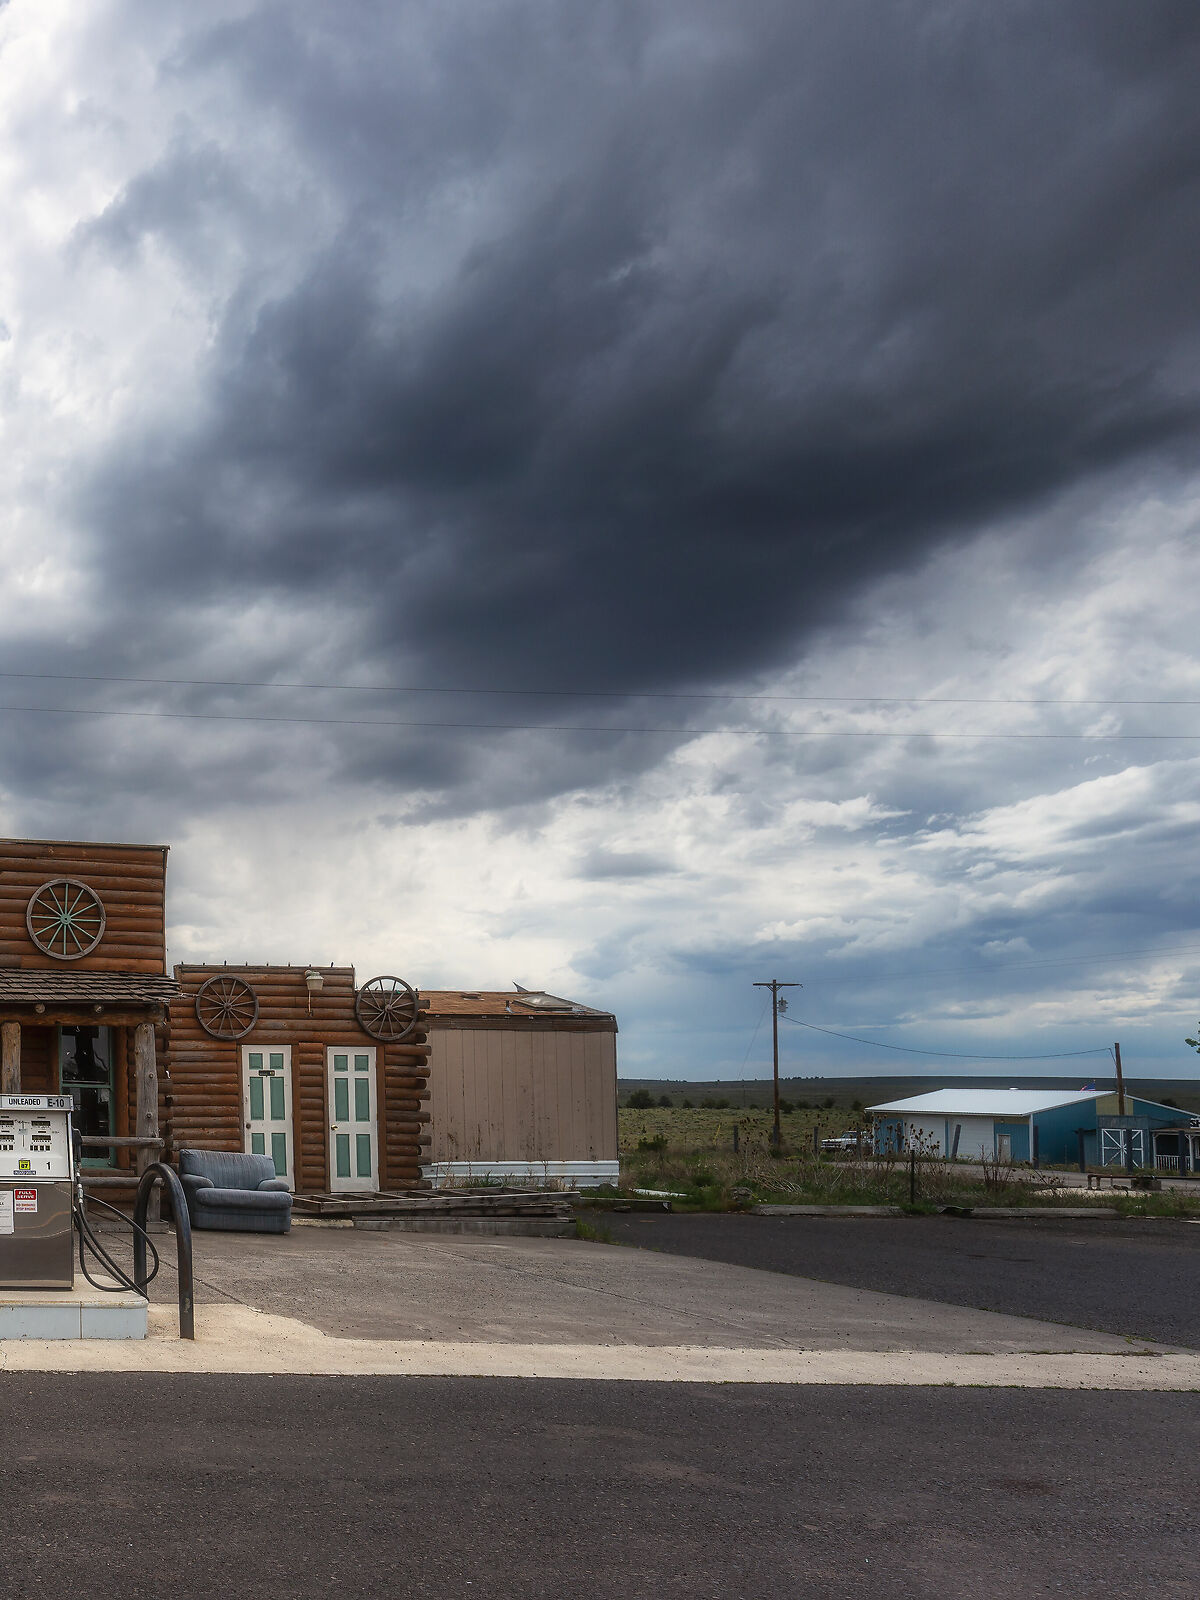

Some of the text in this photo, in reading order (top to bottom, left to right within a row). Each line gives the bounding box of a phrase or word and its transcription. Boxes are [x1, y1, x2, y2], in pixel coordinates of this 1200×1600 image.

[8, 1098, 41, 1106] UNLEADED
[47, 1099, 65, 1108] E-10
[46, 1161, 51, 1170] 1
